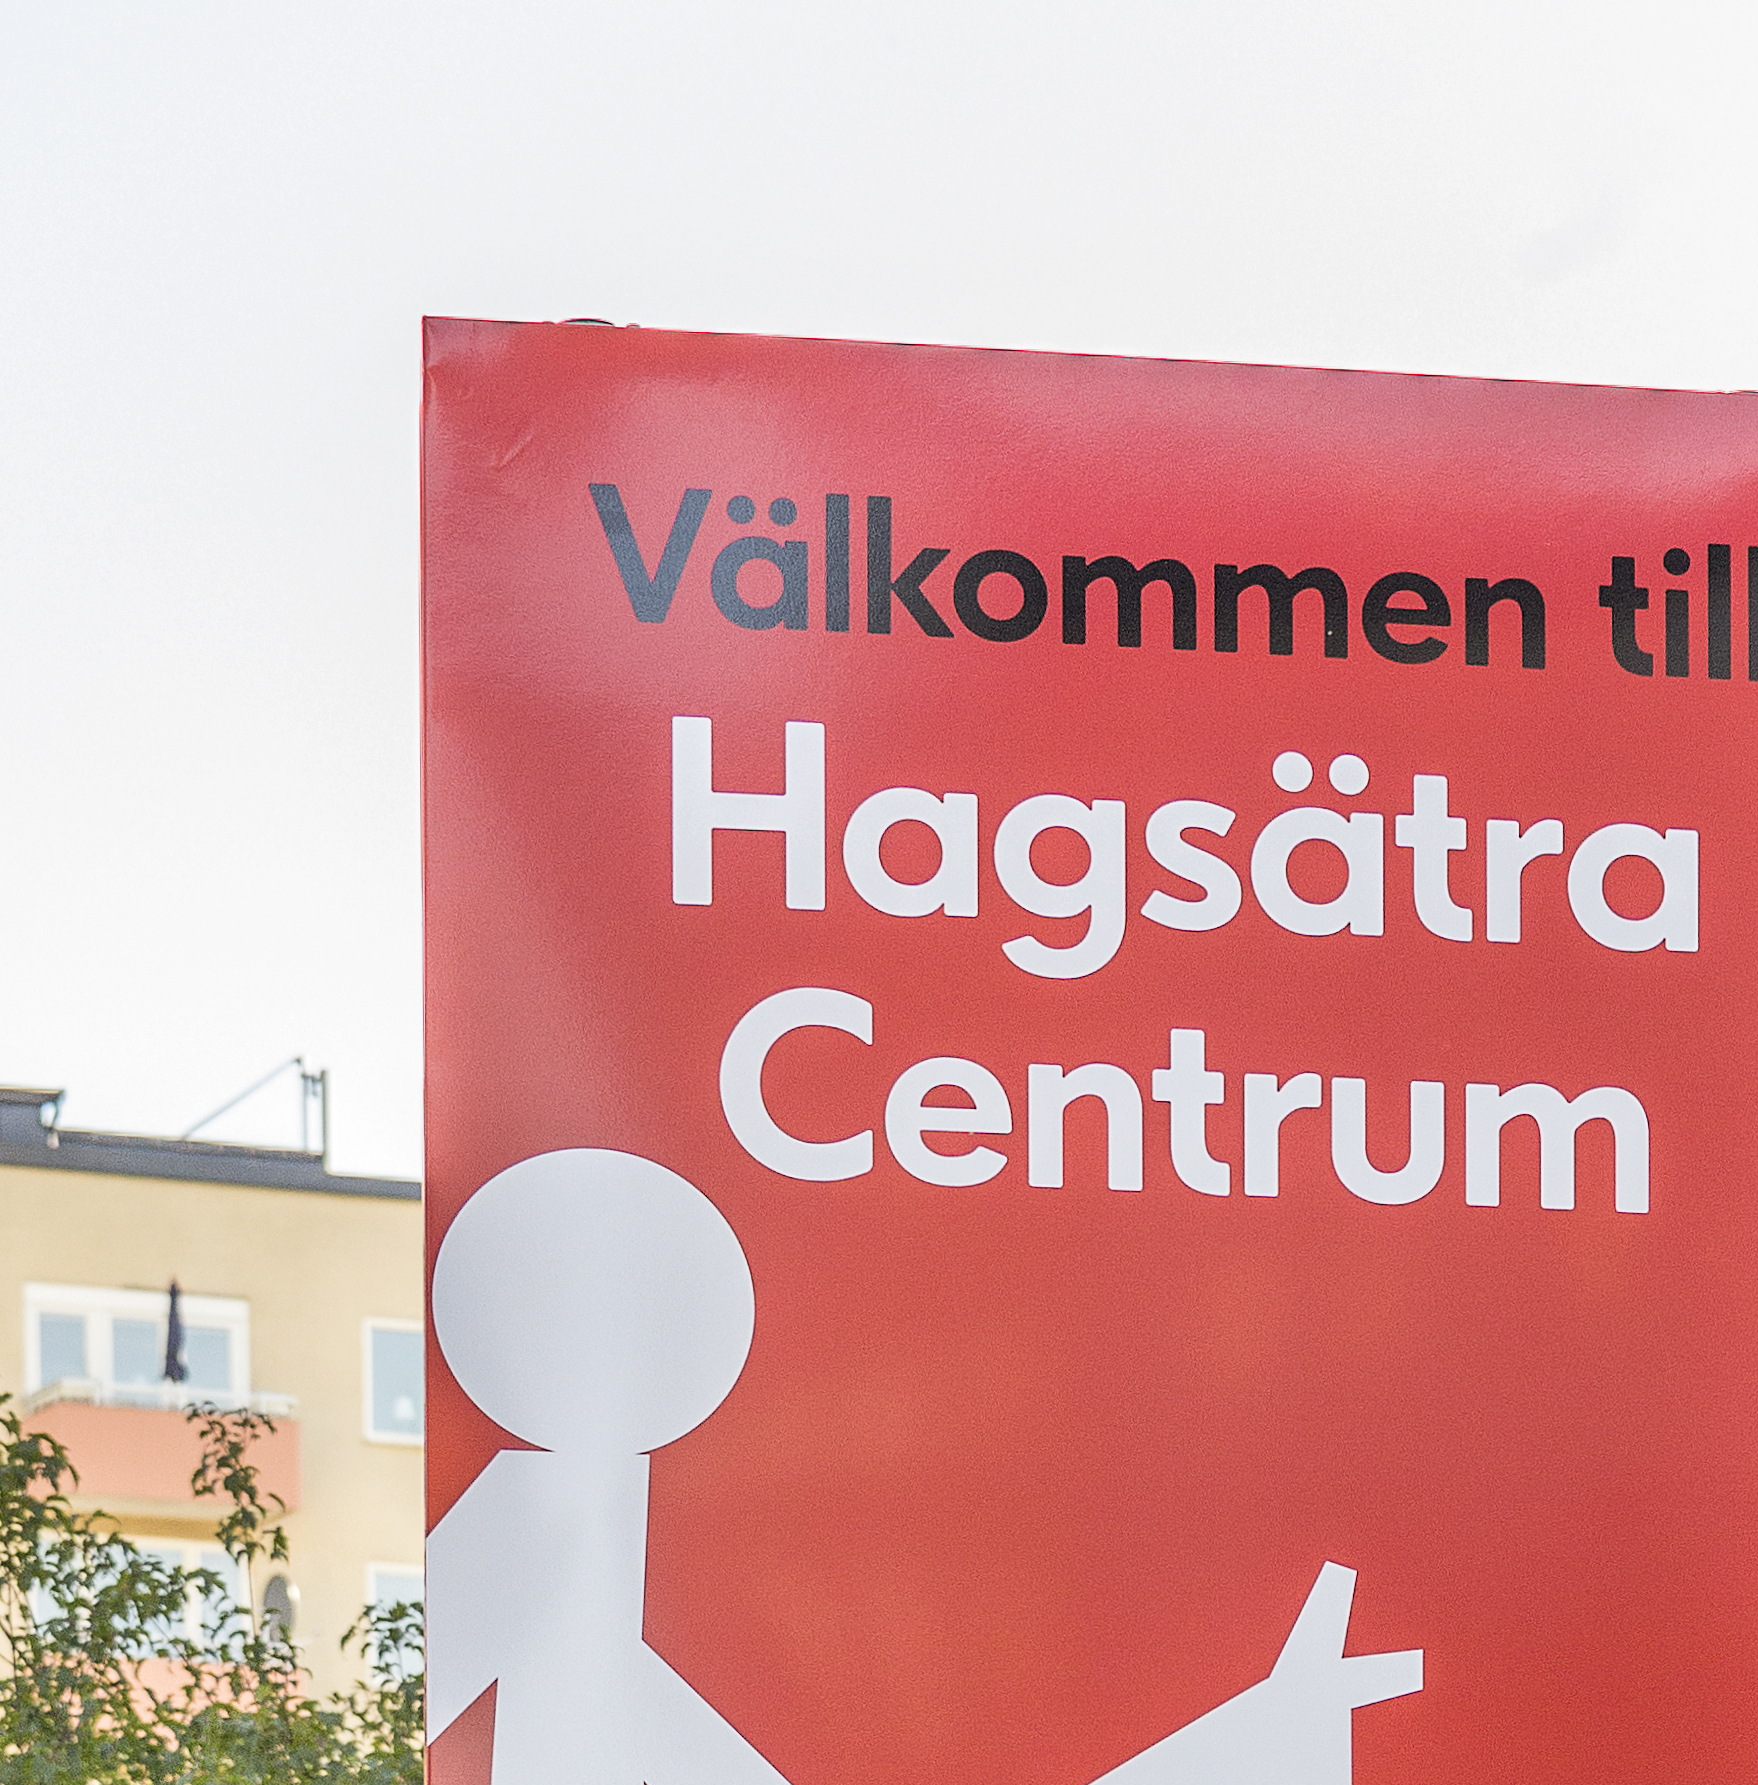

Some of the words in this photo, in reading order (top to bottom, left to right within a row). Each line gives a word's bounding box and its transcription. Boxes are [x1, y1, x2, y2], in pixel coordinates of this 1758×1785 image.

[588, 482, 1546, 669] Välkommen
[671, 715, 1699, 979] Hagsätra
[718, 987, 1650, 1215] Centrum
